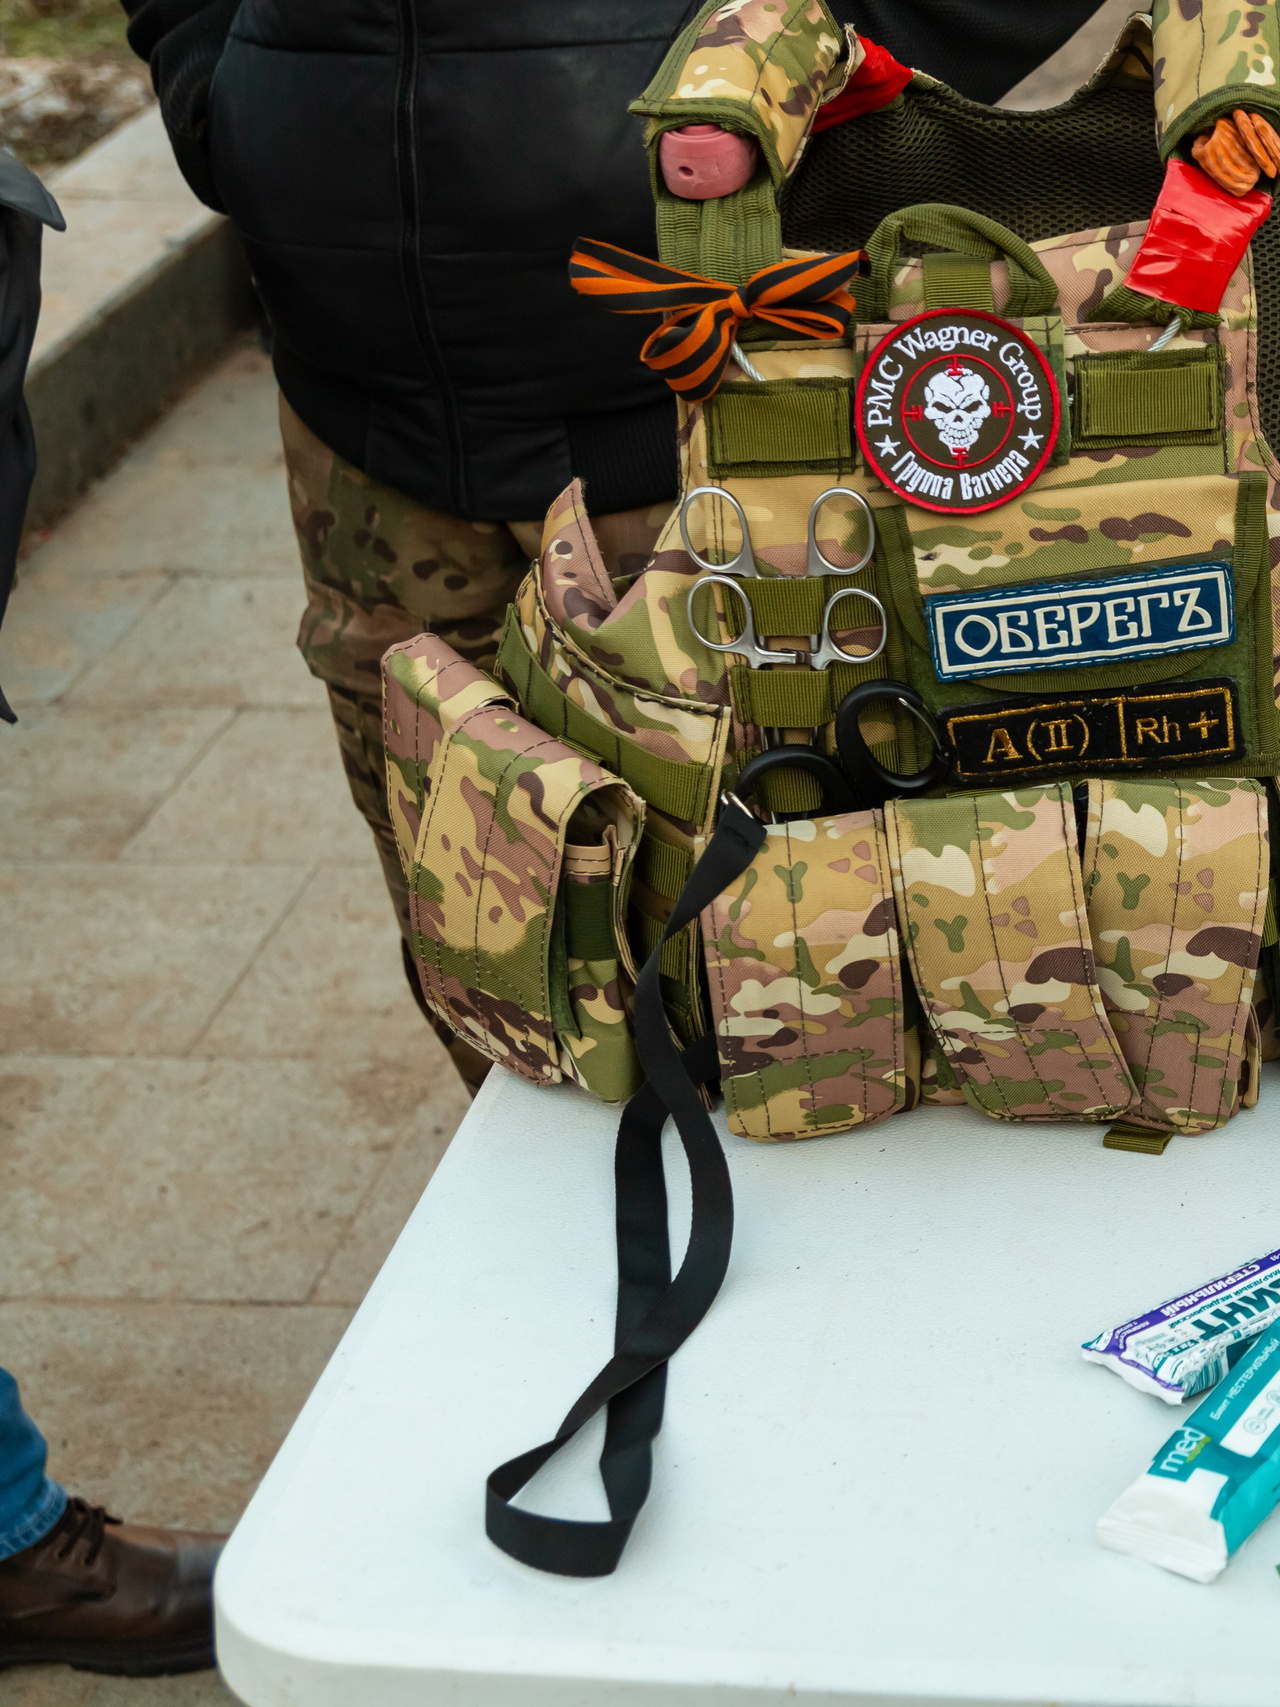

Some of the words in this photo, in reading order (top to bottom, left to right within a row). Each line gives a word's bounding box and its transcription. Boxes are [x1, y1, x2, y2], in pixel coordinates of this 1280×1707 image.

[867, 356, 903, 427] PMC
[893, 326, 998, 360] Wagner
[999, 342, 1041, 420] Group
[891, 451, 954, 500] Группа
[960, 450, 1030, 500] Вагнера
[955, 588, 1212, 657] ОБЕРЕГЪ
[1158, 1261, 1261, 1320] СТЕРИЛЬНЫЙ
[1167, 1292, 1233, 1330] МЕДИЦИНСКИЙ
[1225, 1336, 1280, 1400] НЕСТЕРИЛЬНЫЙ
